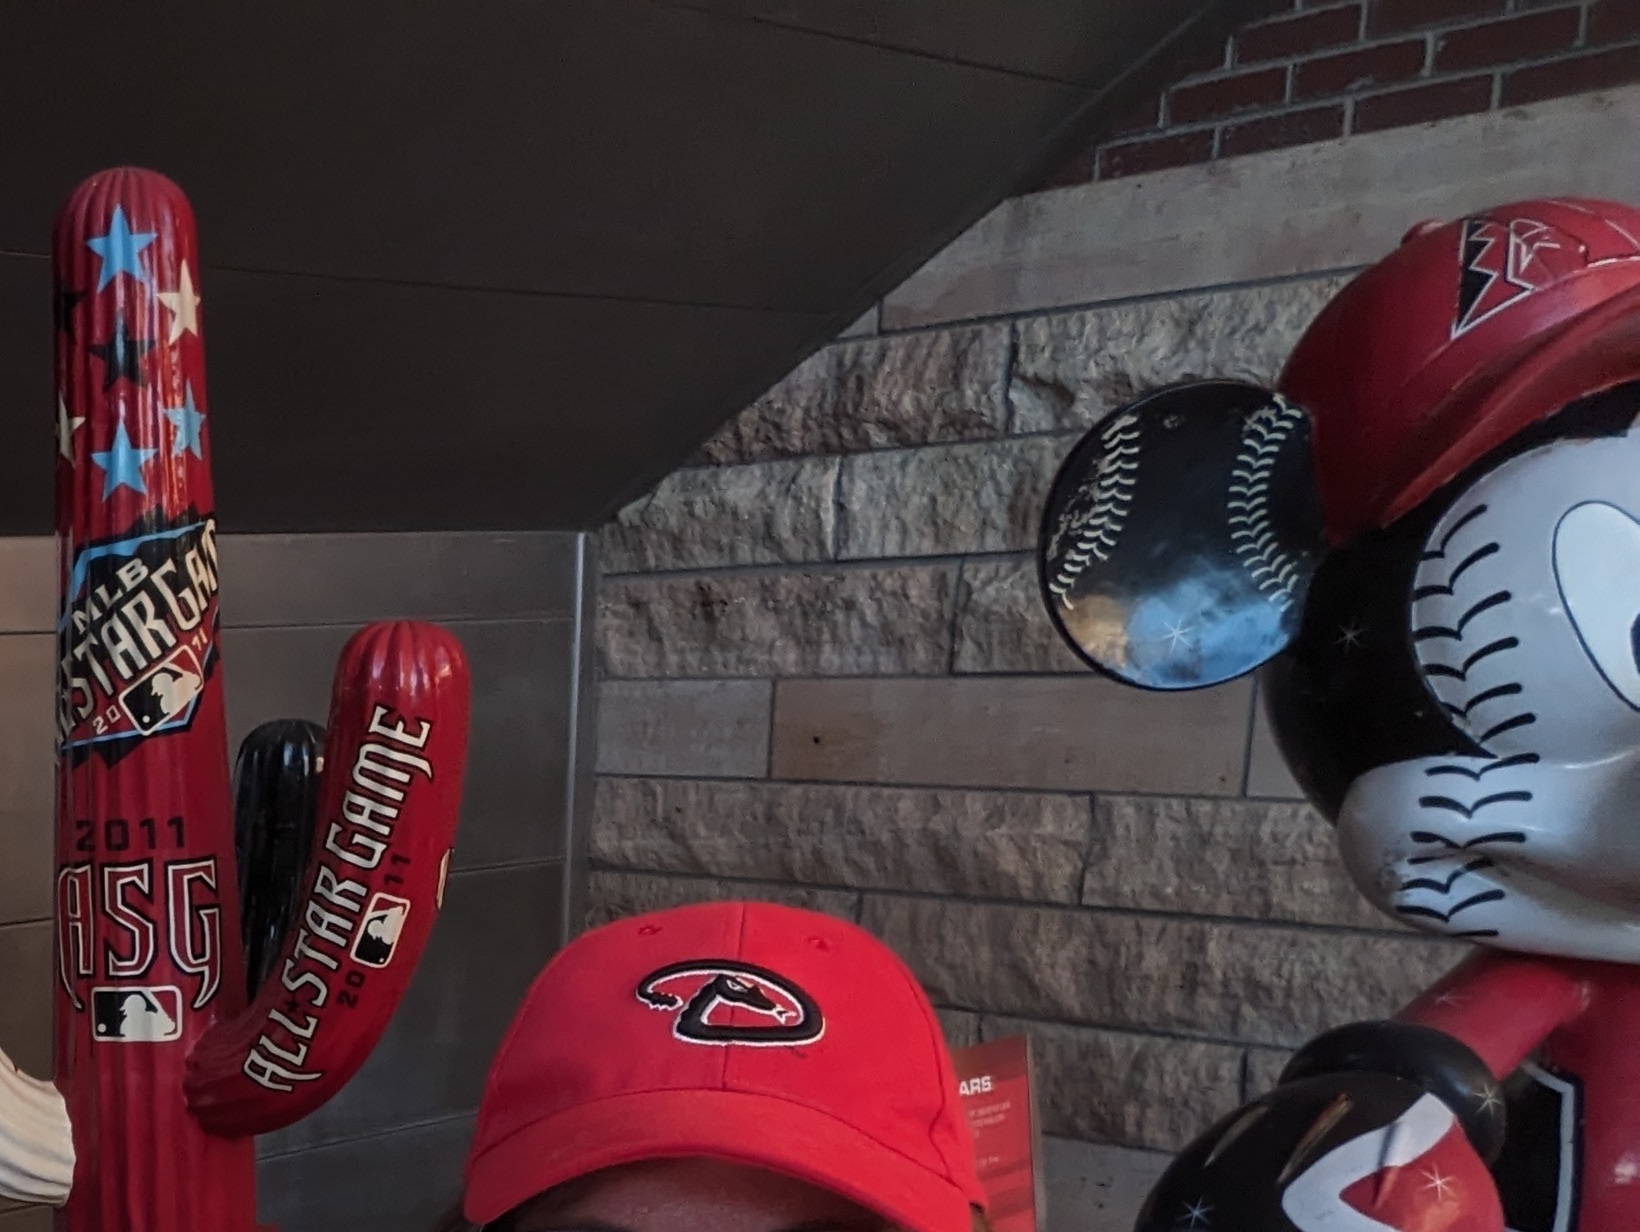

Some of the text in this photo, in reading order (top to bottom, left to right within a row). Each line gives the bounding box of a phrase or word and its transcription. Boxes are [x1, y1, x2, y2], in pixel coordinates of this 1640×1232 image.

[71, 557, 149, 636] MLB
[75, 815, 186, 851] 2011
[326, 705, 433, 870] GAME
[58, 856, 220, 1010] ASG
